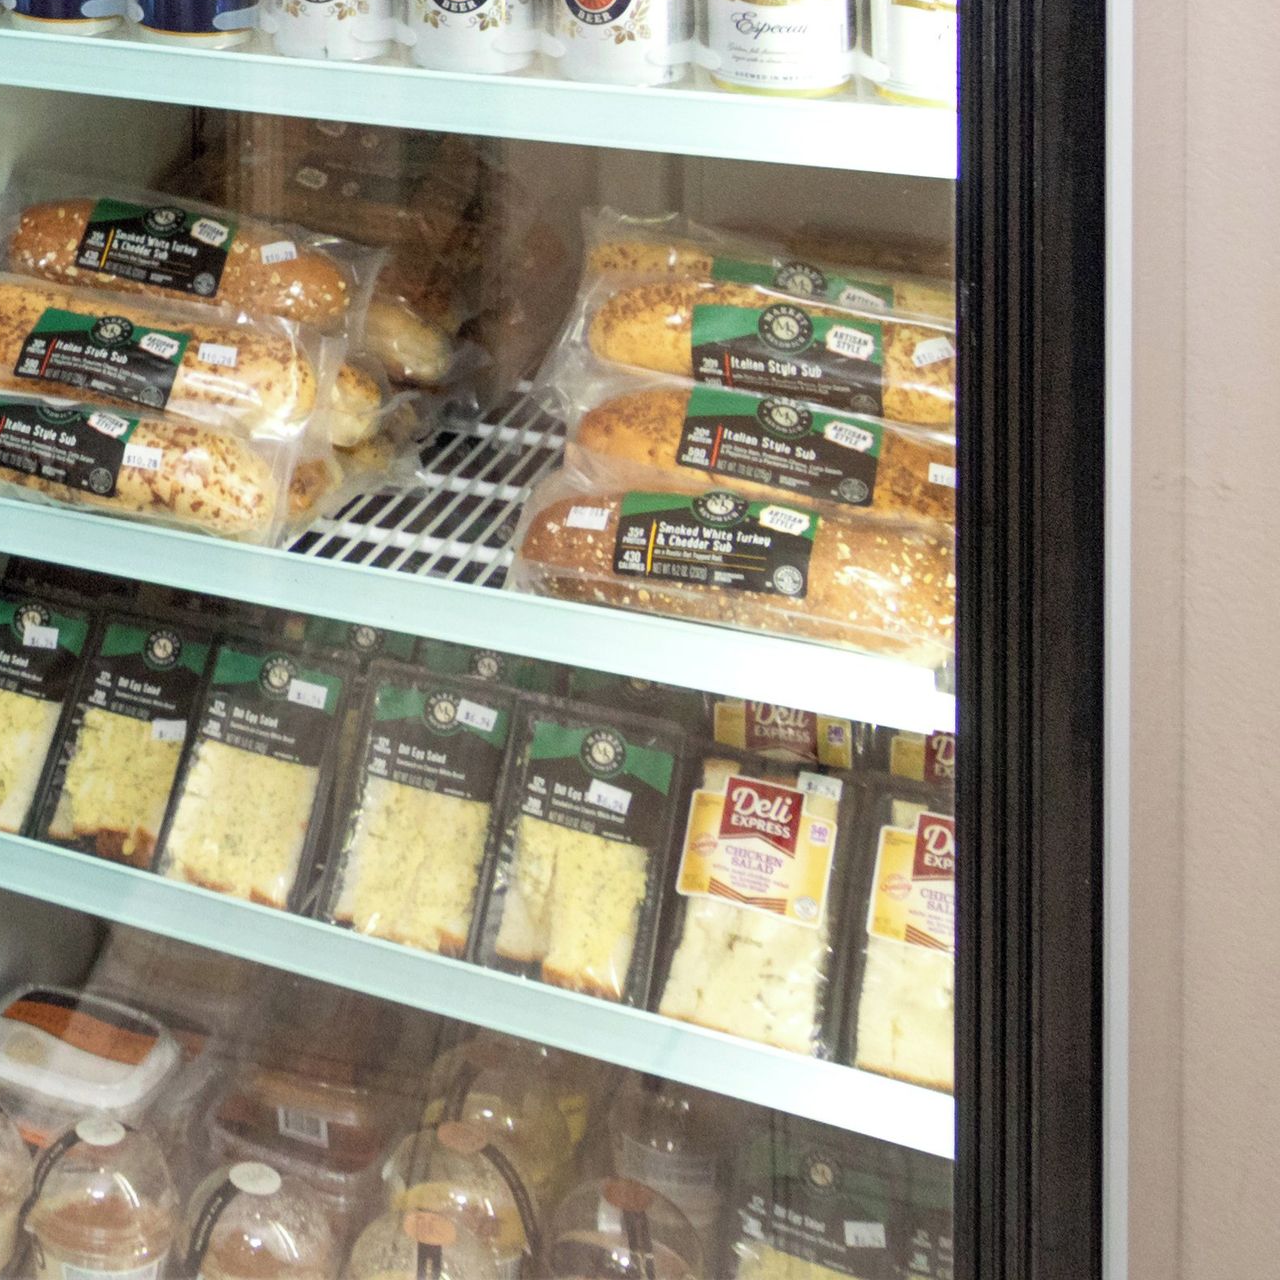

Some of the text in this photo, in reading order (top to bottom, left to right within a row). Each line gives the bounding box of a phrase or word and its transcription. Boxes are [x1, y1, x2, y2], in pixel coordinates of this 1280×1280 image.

[441, 0, 477, 12] BEER
[577, 9, 613, 24] BEER
[832, 330, 869, 346] ARTISAN
[836, 340, 861, 354] STYLE
[56, 339, 128, 364] Italian Style Sub
[730, 356, 822, 378] Italian Style Sub
[5, 417, 77, 447] Italian Style Sub
[723, 428, 757, 447] Italian
[761, 437, 791, 454] Style
[795, 445, 817, 461] Sub
[659, 521, 771, 548] Smoked White Turkey
[712, 540, 733, 553] Sub
[731, 786, 793, 824] Deli
[730, 815, 790, 839] EXPRESS
[725, 845, 783, 868] CHICKEN
[730, 856, 775, 875] SALAD
[920, 888, 954, 905] CHIC
[926, 900, 954, 914] SAL
